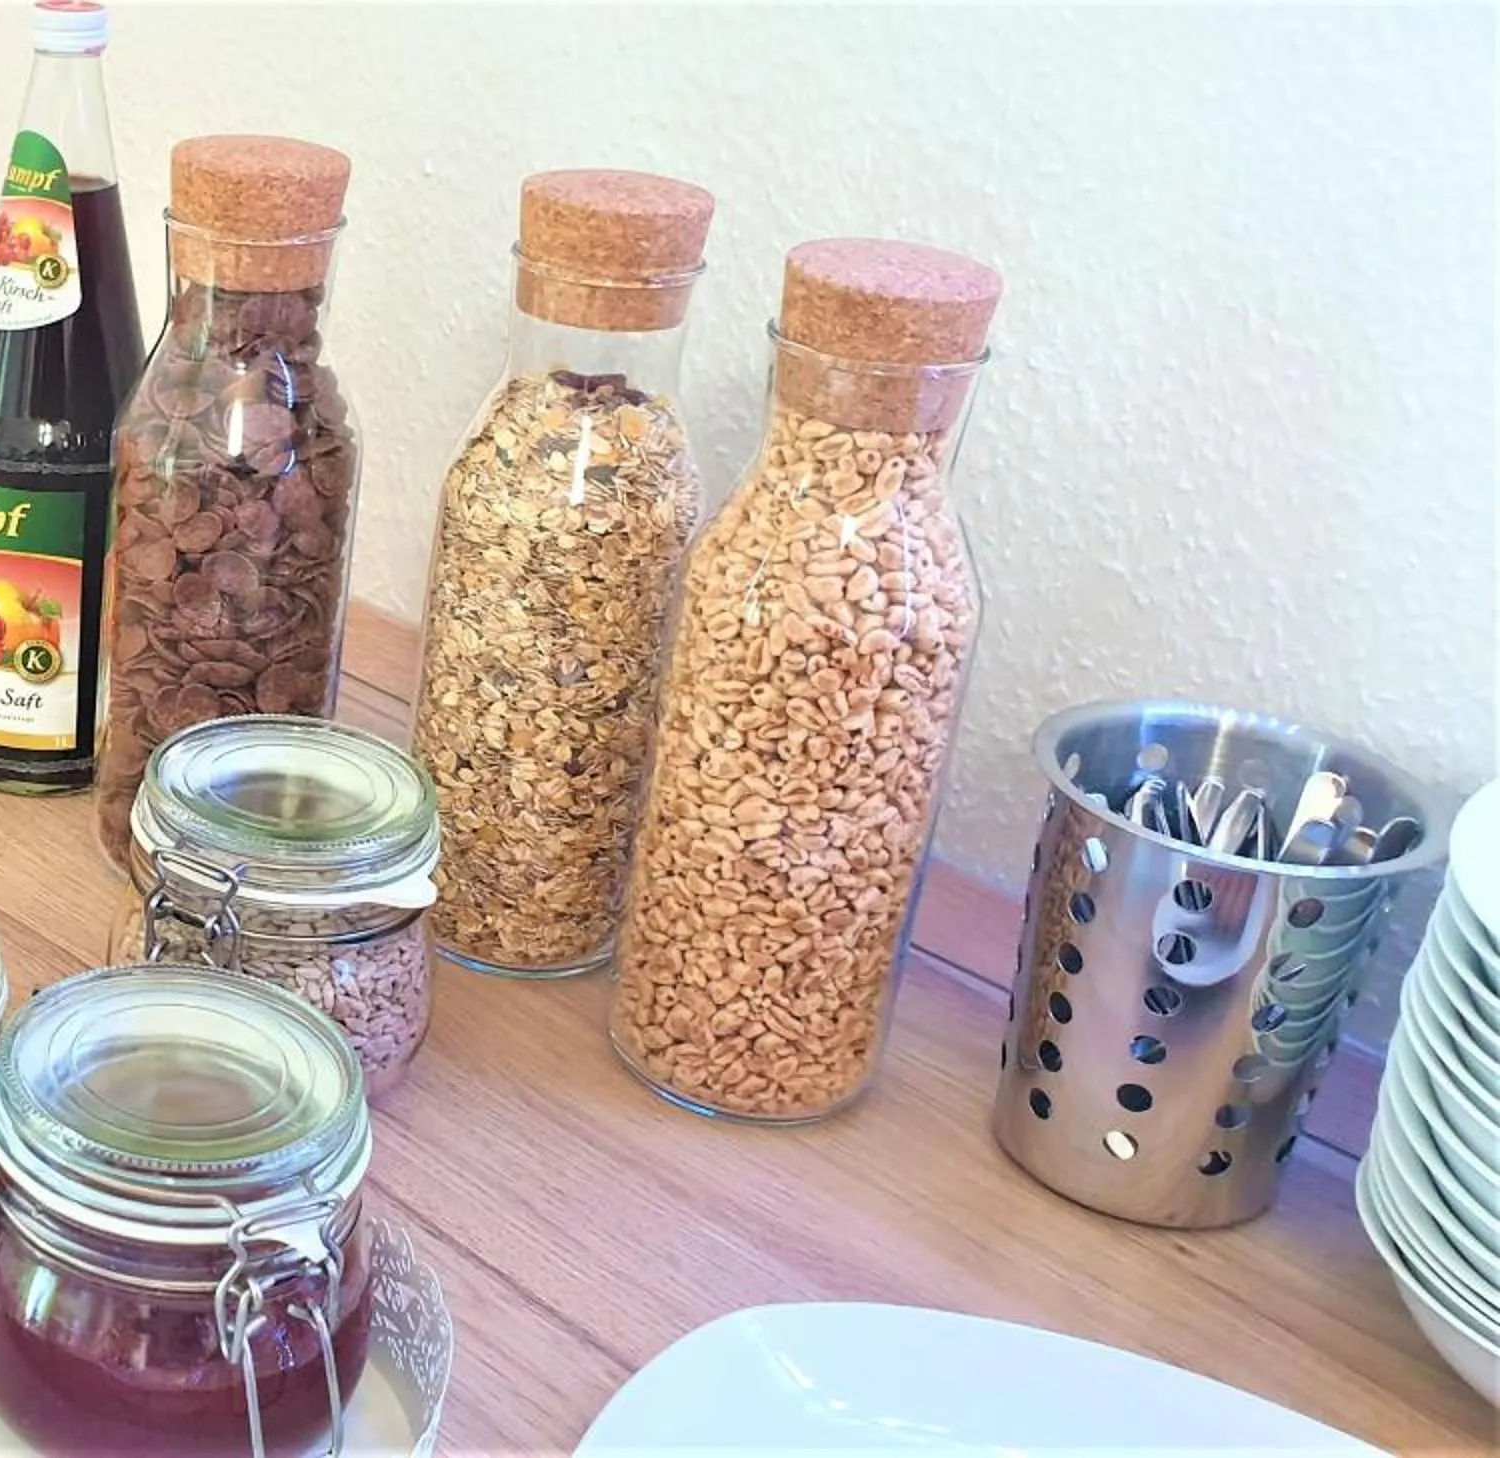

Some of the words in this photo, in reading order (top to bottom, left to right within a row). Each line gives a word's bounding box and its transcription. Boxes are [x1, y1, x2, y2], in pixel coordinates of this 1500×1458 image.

[7, 165, 62, 193] umpf
[40, 260, 59, 280] K
[26, 648, 47, 672] K
